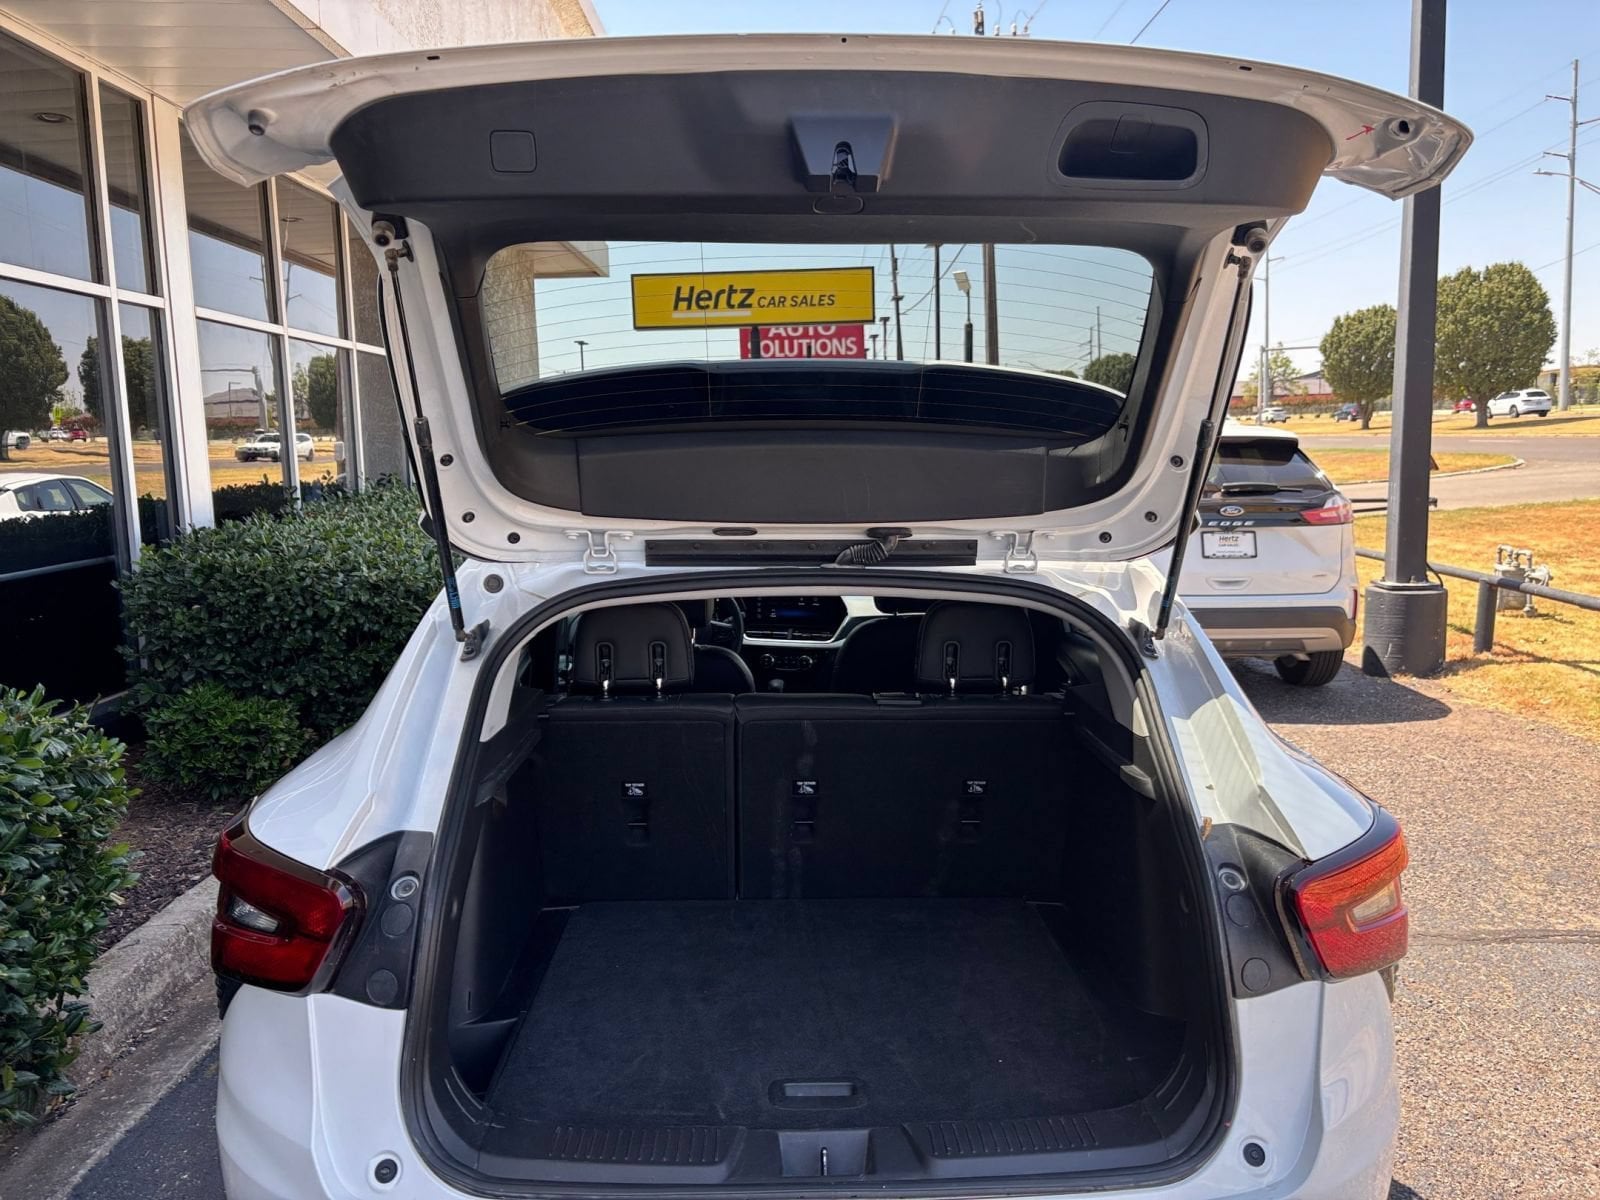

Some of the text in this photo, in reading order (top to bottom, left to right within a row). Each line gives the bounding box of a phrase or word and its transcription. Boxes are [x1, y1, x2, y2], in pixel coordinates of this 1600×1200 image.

[673, 284, 836, 311] Hertz CAR SALES
[747, 337, 858, 358] OLUTIONS
